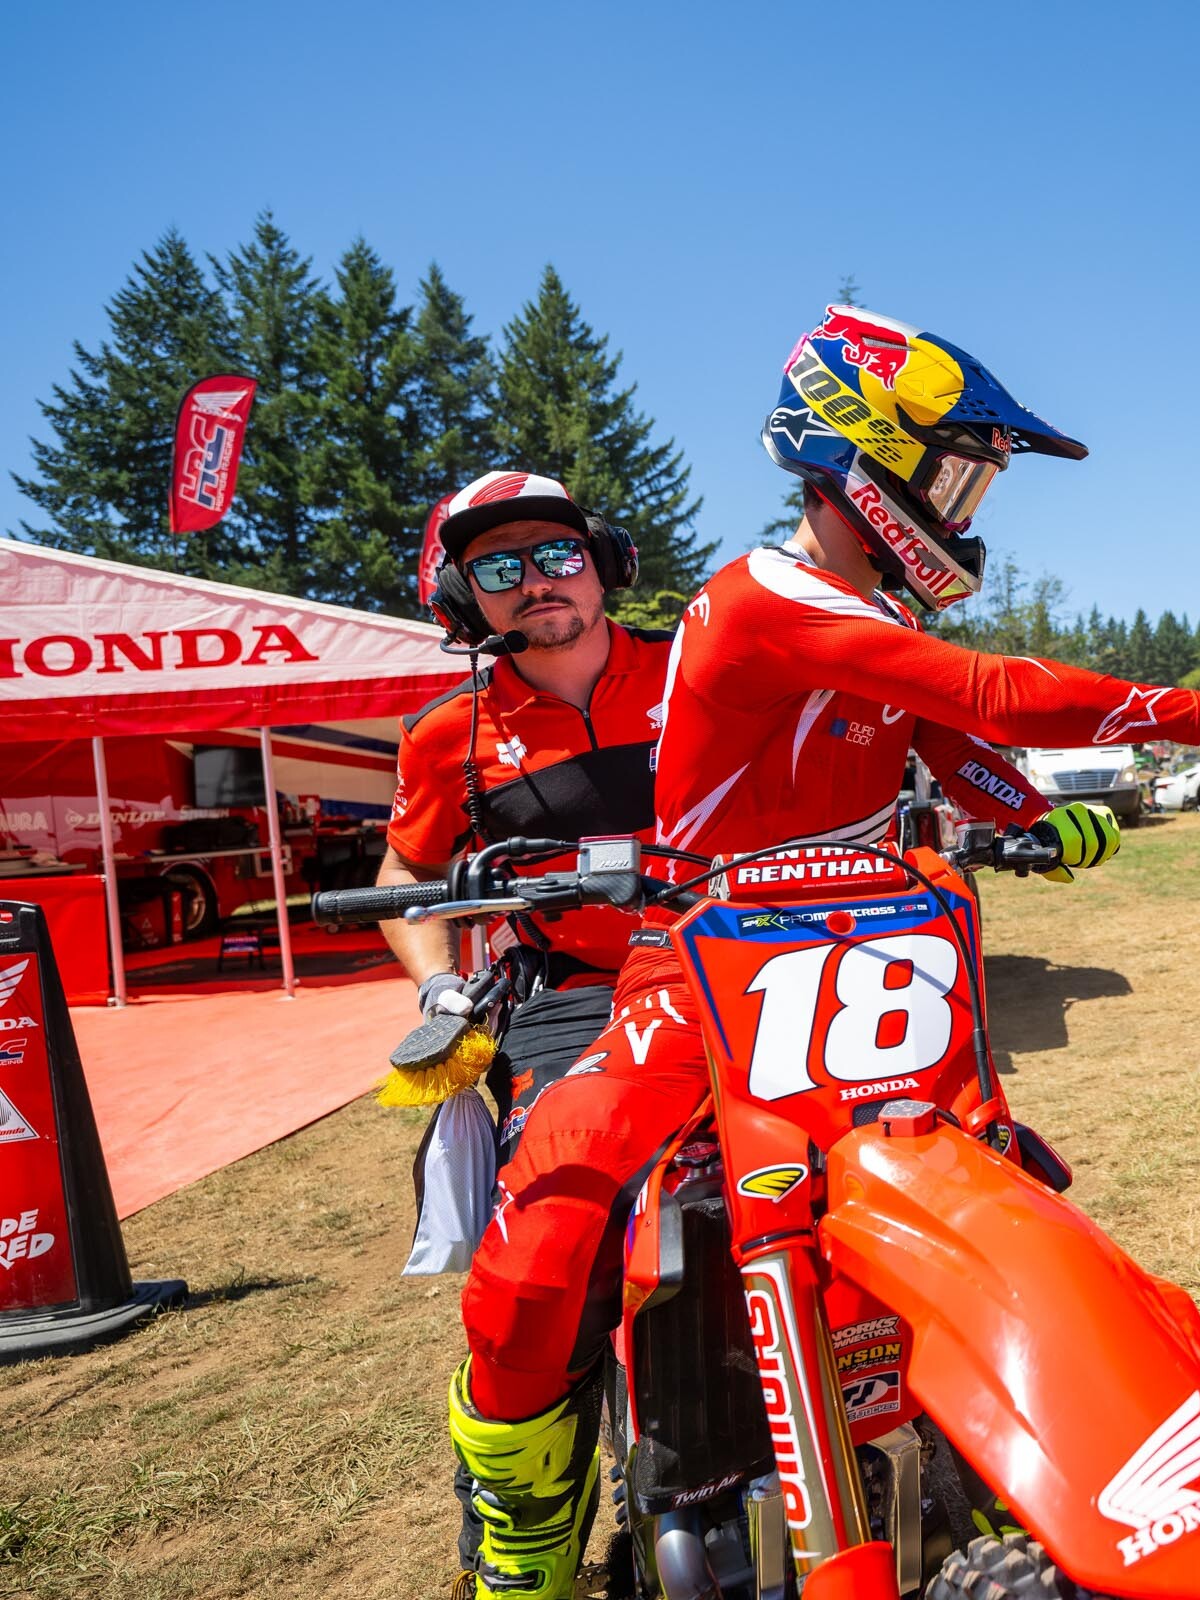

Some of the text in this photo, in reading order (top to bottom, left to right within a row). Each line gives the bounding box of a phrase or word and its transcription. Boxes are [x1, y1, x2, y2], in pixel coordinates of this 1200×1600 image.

[957, 760, 1027, 810] HONDA
[737, 857, 894, 885] RENTHAL
[744, 934, 958, 1101] 18
[839, 1078, 919, 1101] HONDA
